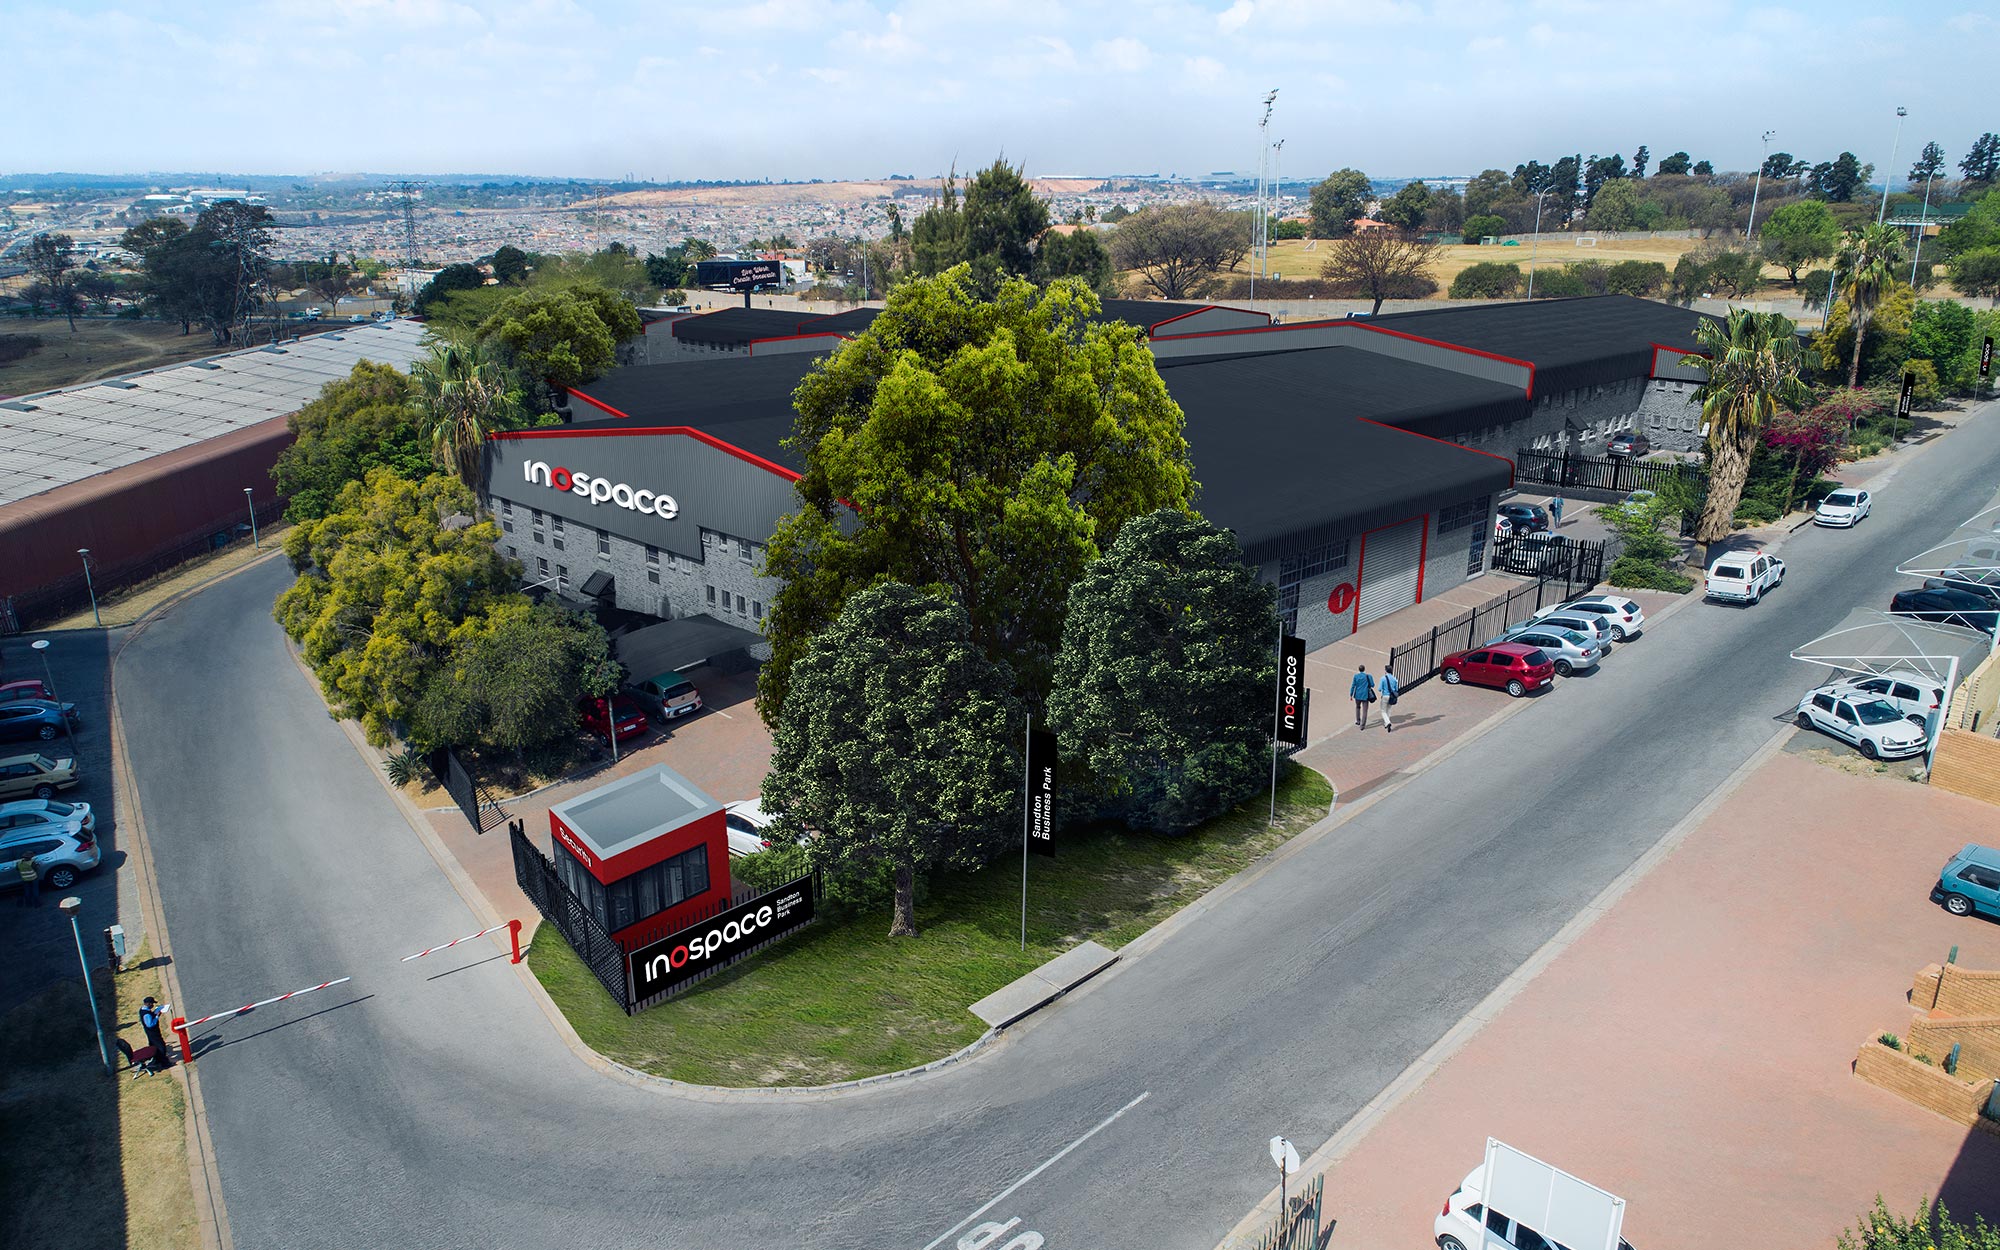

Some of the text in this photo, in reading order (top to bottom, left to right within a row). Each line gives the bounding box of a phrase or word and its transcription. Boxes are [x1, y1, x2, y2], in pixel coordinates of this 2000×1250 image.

[524, 459, 679, 520] inospace
[1338, 588, 1345, 608] 1
[1284, 656, 1297, 729] inospace
[1032, 796, 1042, 838] Sandton
[1042, 767, 1052, 840] Business Park
[560, 826, 592, 867] Security
[776, 891, 800, 906] Sandton
[776, 896, 803, 913] Business
[777, 909, 791, 919] Park
[645, 905, 773, 982] inospace
